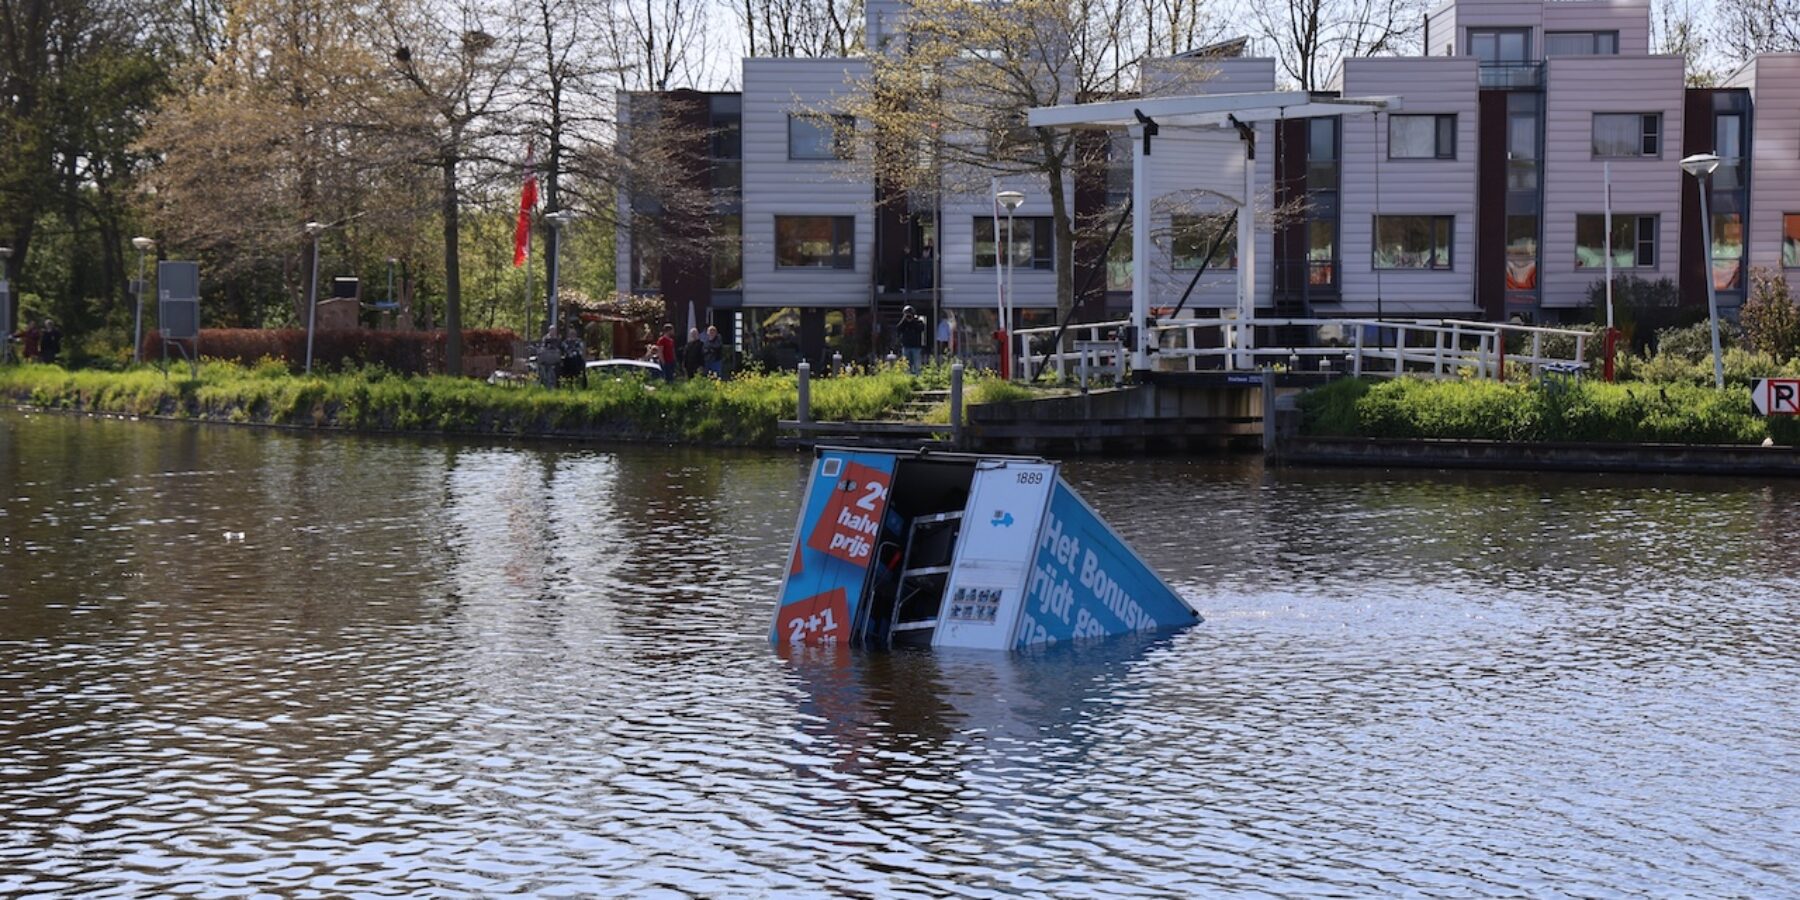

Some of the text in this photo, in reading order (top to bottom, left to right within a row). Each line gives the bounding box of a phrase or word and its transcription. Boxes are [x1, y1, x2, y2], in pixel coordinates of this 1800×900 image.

[1016, 471, 1043, 485] 1889
[829, 532, 870, 557] prijs
[1042, 511, 1080, 575] Het
[1030, 563, 1111, 638] rijdt ge
[788, 607, 838, 642] 2+1
[1019, 613, 1057, 645] na
